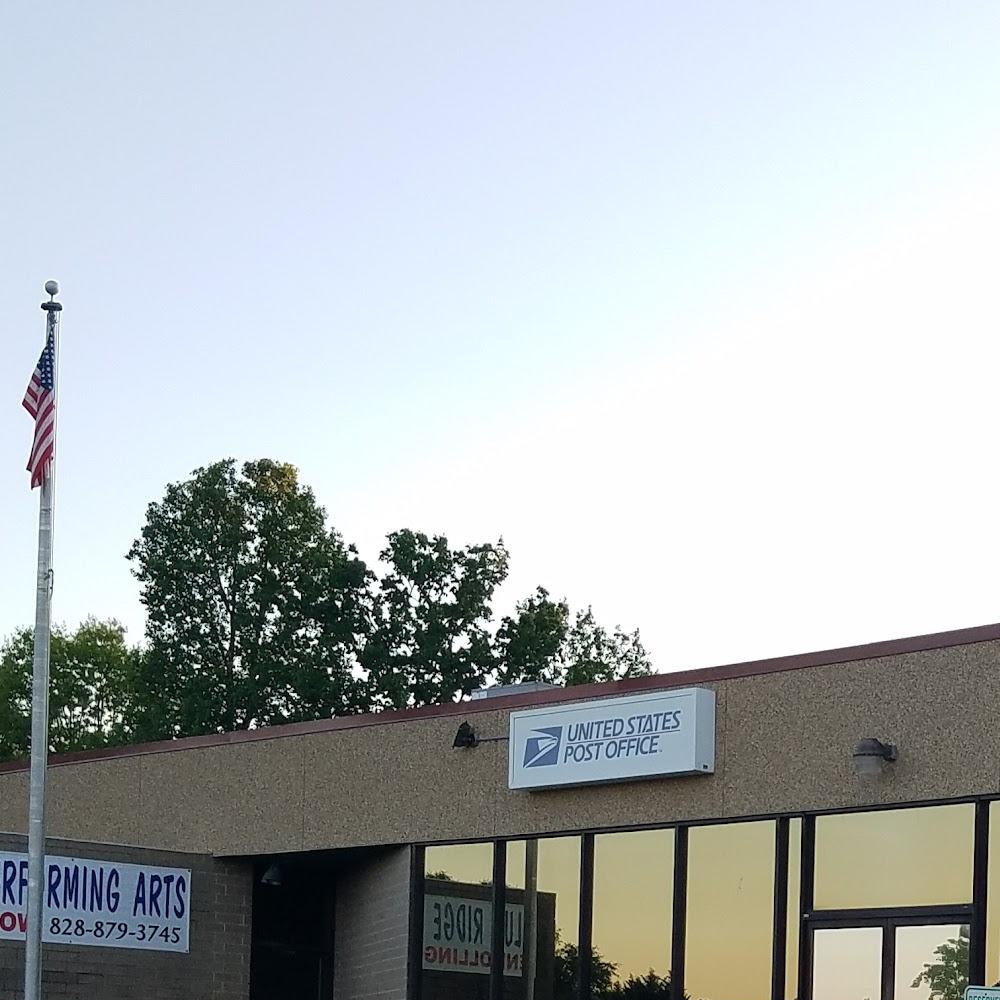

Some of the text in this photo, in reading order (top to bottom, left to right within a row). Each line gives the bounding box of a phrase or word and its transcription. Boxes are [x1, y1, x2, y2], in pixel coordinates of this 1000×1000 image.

[567, 710, 682, 742] UNITED STATES
[563, 735, 660, 764] POST OFFICE
[2, 860, 187, 919] RFRMING ARTS
[50, 917, 182, 944] 828-879-3745
